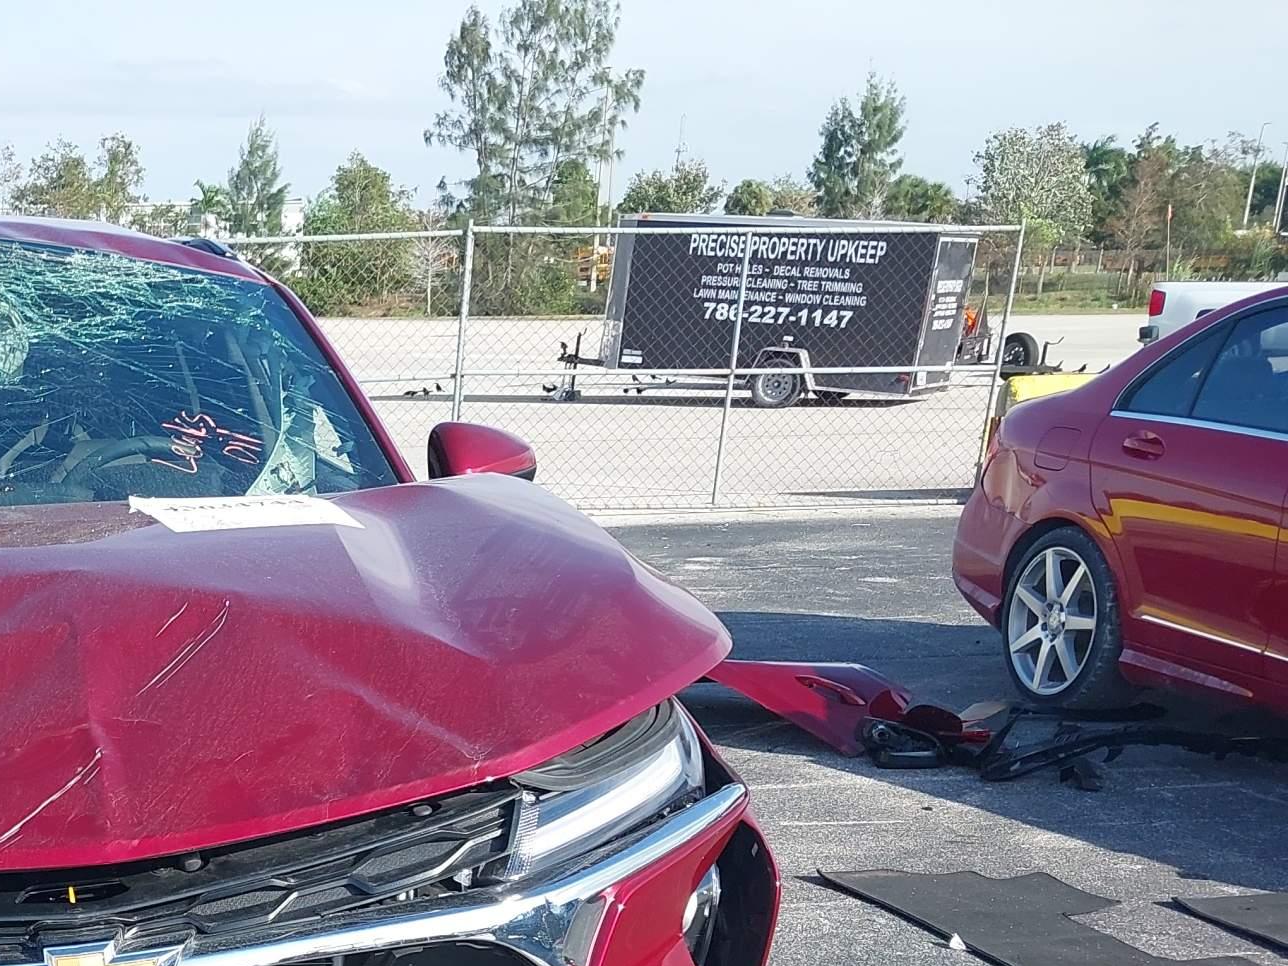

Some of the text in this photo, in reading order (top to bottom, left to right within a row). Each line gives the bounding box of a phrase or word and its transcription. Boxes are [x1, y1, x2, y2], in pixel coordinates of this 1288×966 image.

[689, 234, 887, 264] PRECISE PROPERTY UPKEEP
[717, 263, 734, 273] POT
[735, 264, 763, 274] HLES
[773, 265, 801, 277] DECAL
[803, 267, 850, 279] REMOVALS
[701, 275, 742, 287] PRESSUR
[746, 277, 789, 290] CLEANING
[797, 280, 819, 291] TREE
[821, 281, 863, 293] TRIMMING
[693, 288, 716, 298] LAWN
[718, 289, 777, 302] MAINENANCE
[785, 293, 822, 304] WINDOW
[822, 295, 867, 306] CLEANING
[703, 302, 853, 328] 786-227-1147
